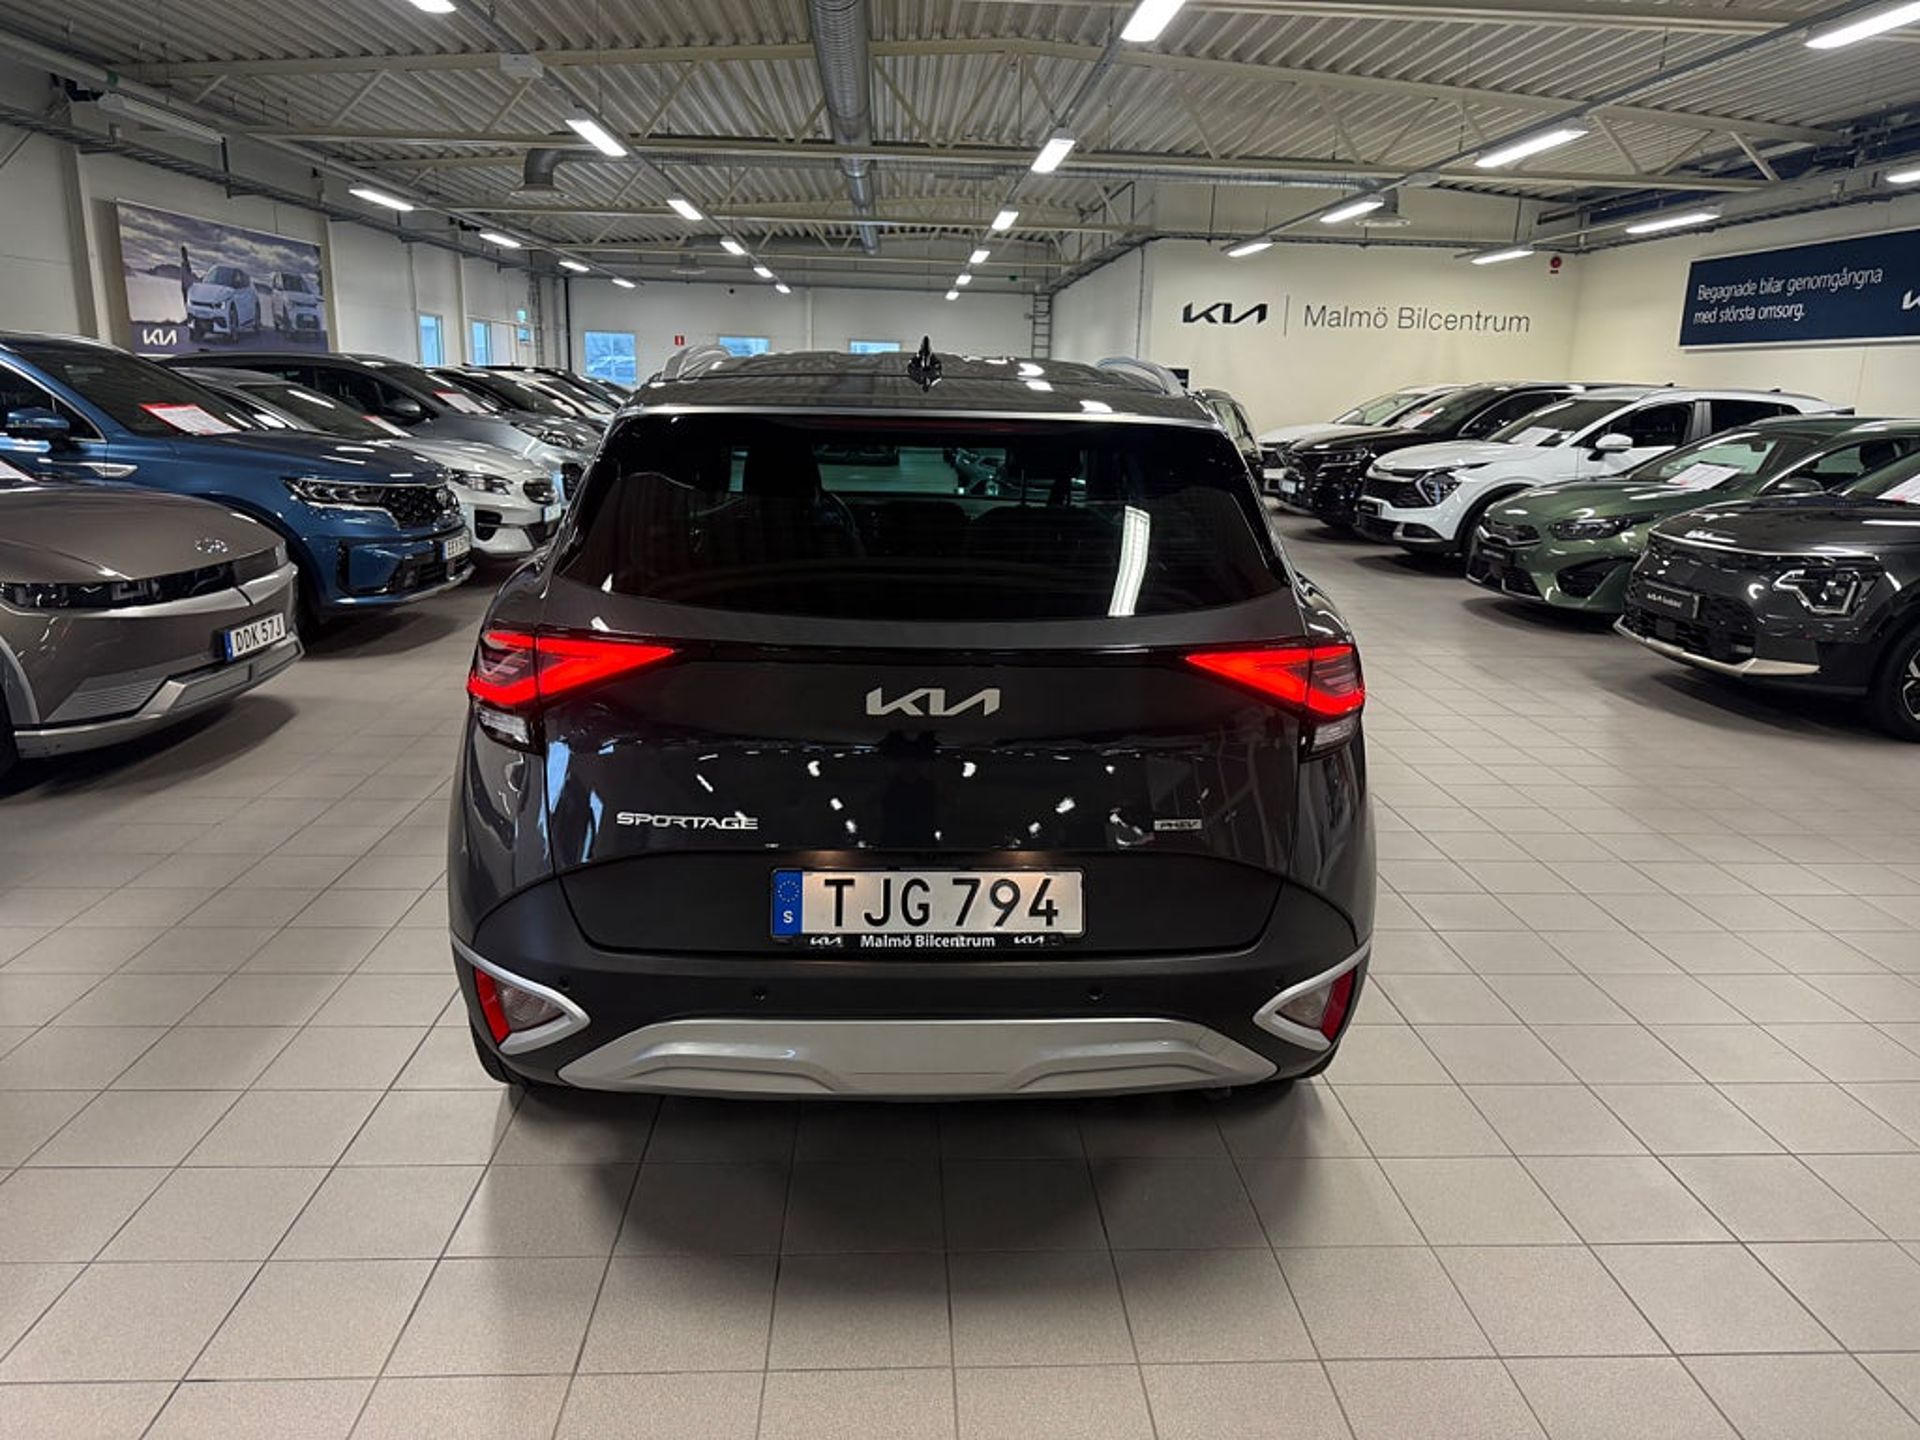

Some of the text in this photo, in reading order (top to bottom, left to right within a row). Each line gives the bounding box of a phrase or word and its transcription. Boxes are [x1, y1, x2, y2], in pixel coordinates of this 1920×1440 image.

[1696, 267, 1883, 304] Begagnade bilar genomgångna
[1182, 302, 1268, 324] KIA
[1304, 305, 1531, 333] Malmö Bilcentrum
[1693, 303, 1806, 325] med största omsorg.
[142, 328, 177, 346] KIA
[866, 687, 1001, 716] KIA
[616, 811, 758, 831] SPORTAGE
[824, 878, 1059, 927] TJG 794
[783, 911, 794, 924] S
[860, 934, 912, 948] Malmö
[915, 934, 996, 948] Bilcentrum
